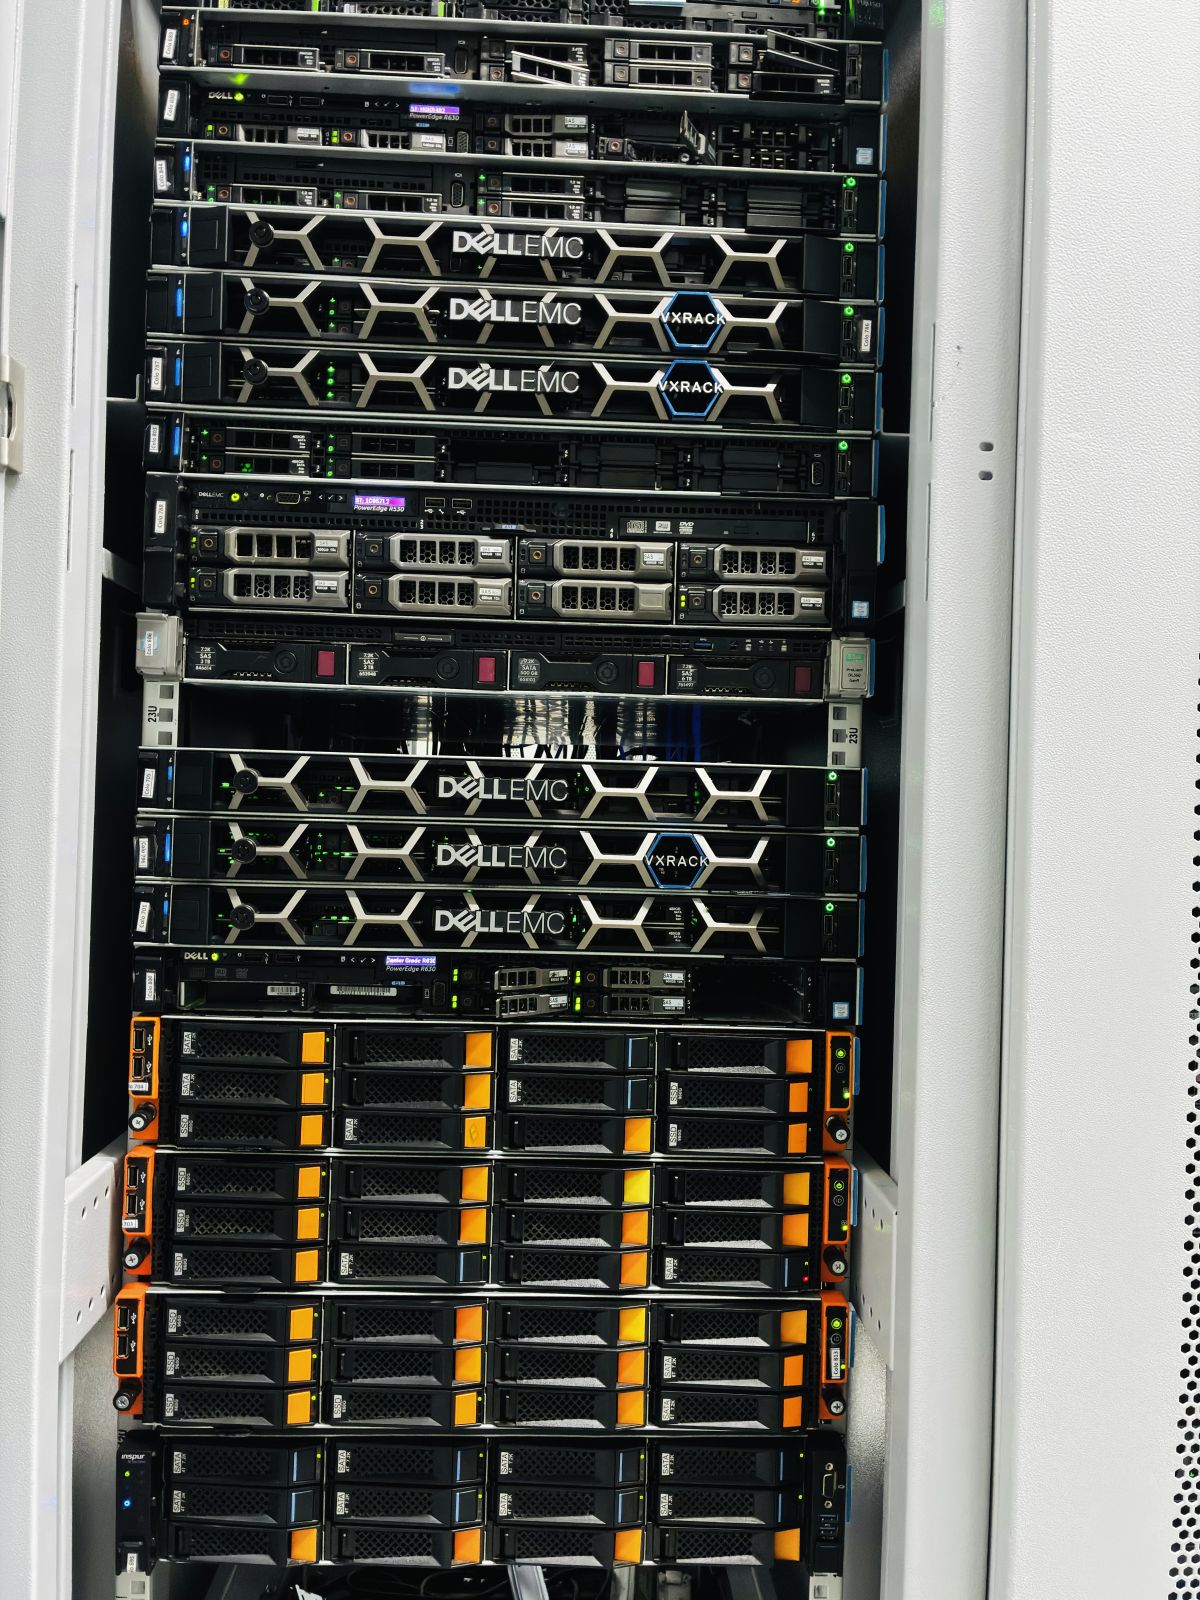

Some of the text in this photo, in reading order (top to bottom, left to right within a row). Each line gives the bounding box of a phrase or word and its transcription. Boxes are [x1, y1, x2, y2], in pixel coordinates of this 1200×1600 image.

[410, 112, 442, 120] PowerEdge
[661, 312, 726, 325] VXRACK
[658, 381, 724, 393] VXRACK
[148, 705, 158, 723] 23U
[849, 727, 858, 744] 23U
[645, 855, 710, 867] VXRACK
[184, 952, 208, 960] DELL
[386, 965, 420, 973] PowerEdge
[183, 1034, 191, 1053] SATA
[510, 1040, 518, 1059] SATA
[182, 1075, 190, 1094] SATA
[181, 1117, 189, 1134] SSD
[345, 1120, 353, 1139] SATA
[177, 1212, 185, 1229] SSD
[665, 1259, 673, 1278] SATA
[662, 1400, 670, 1419] SATA
